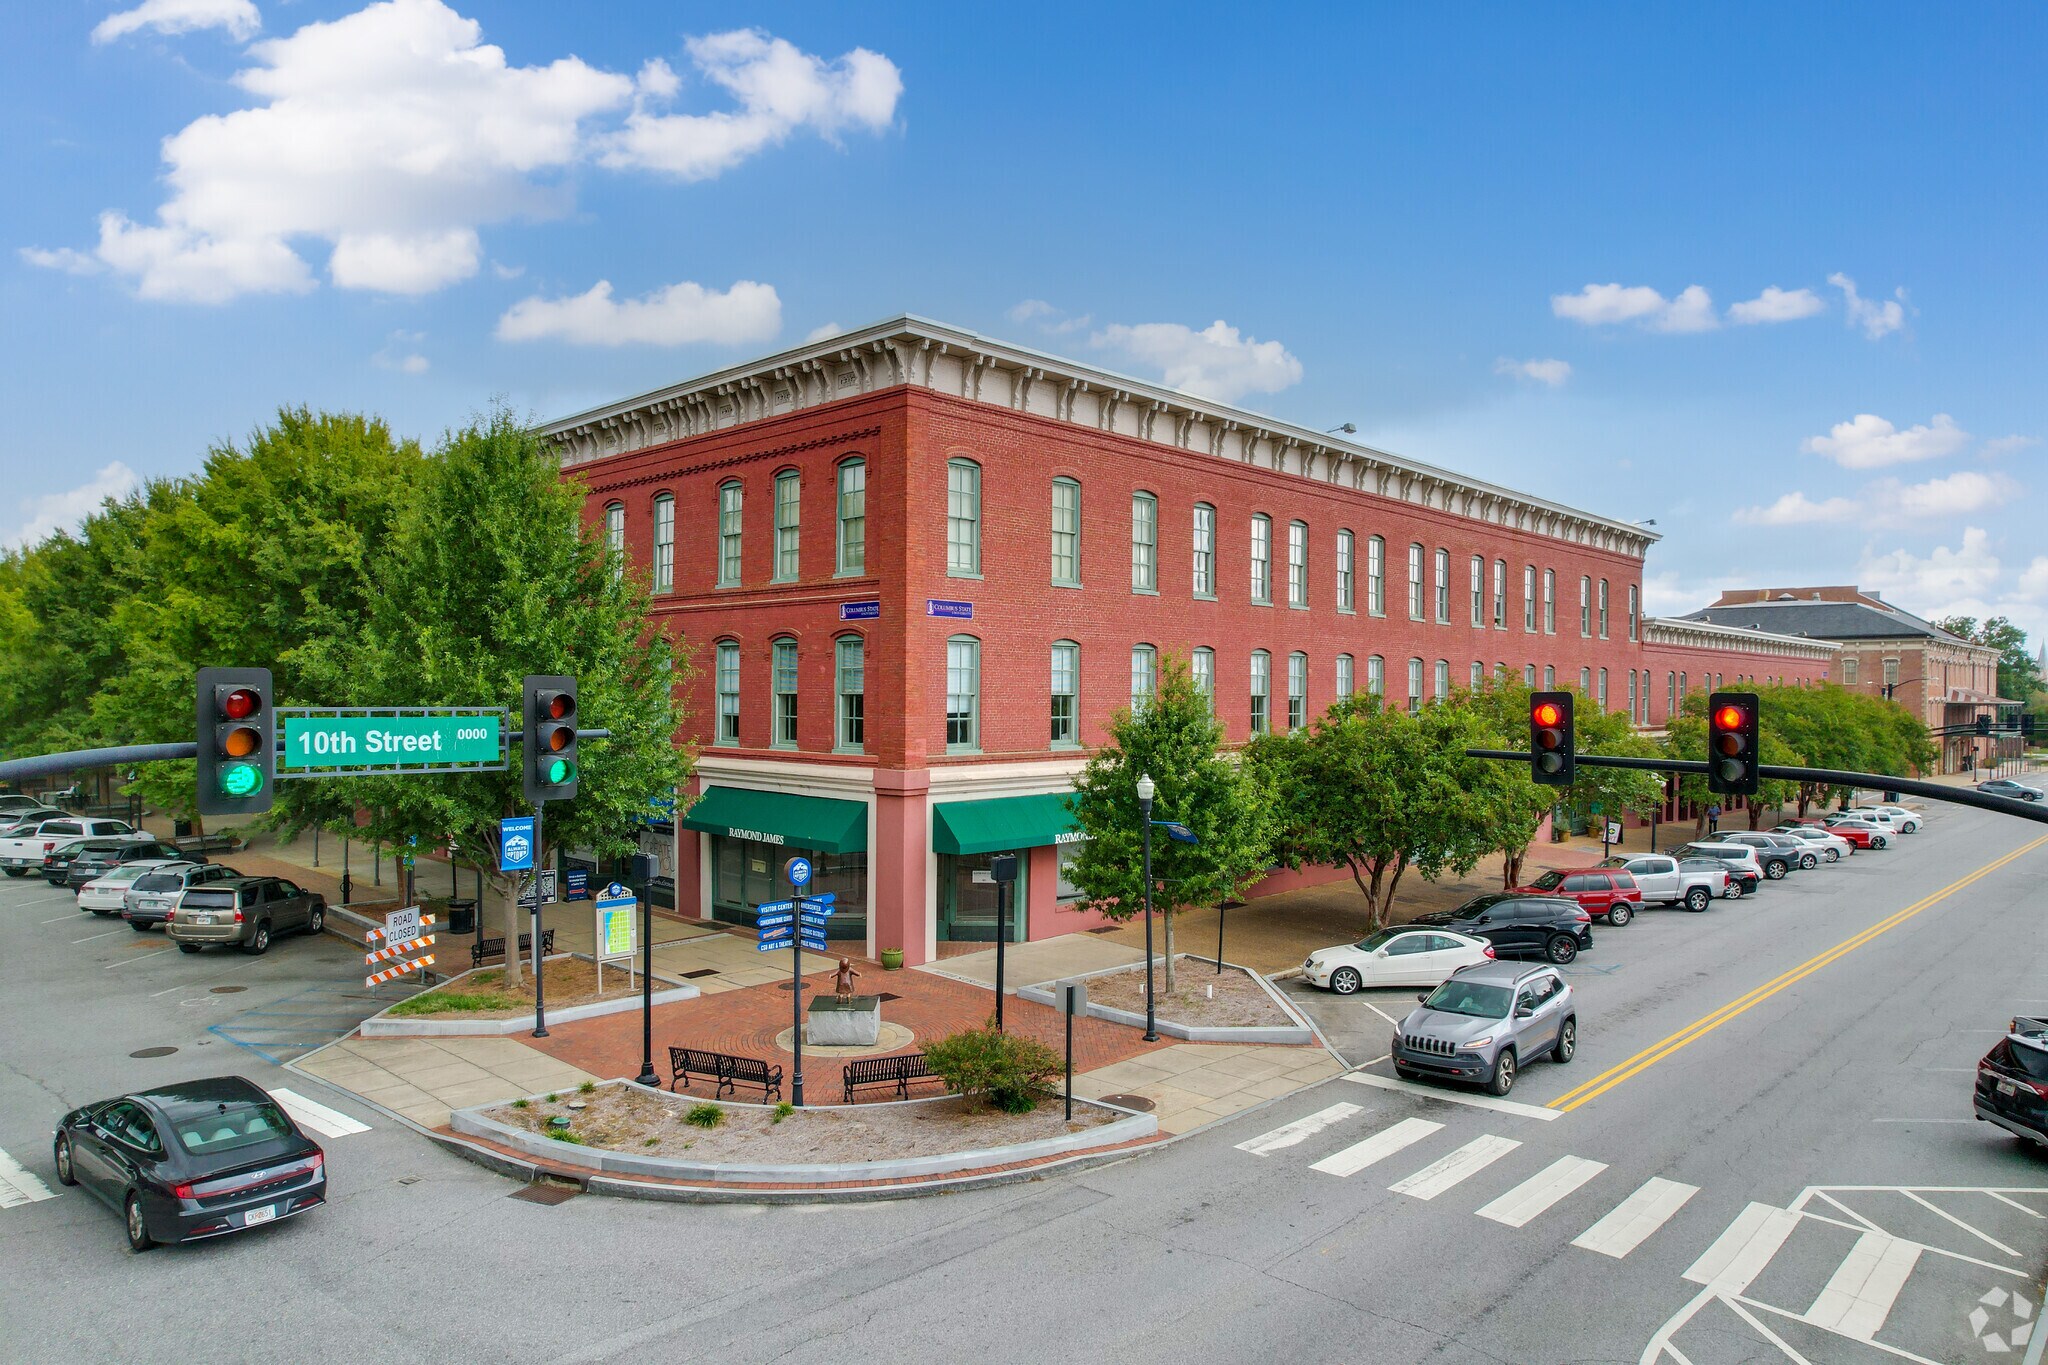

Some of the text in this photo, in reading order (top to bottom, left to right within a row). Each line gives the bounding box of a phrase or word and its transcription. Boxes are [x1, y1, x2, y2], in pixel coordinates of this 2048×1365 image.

[298, 728, 487, 754] 10th Street 0000
[729, 827, 784, 845] RAYMOND JAMES
[393, 912, 413, 927] ROAD
[389, 925, 417, 942] CLOSED
